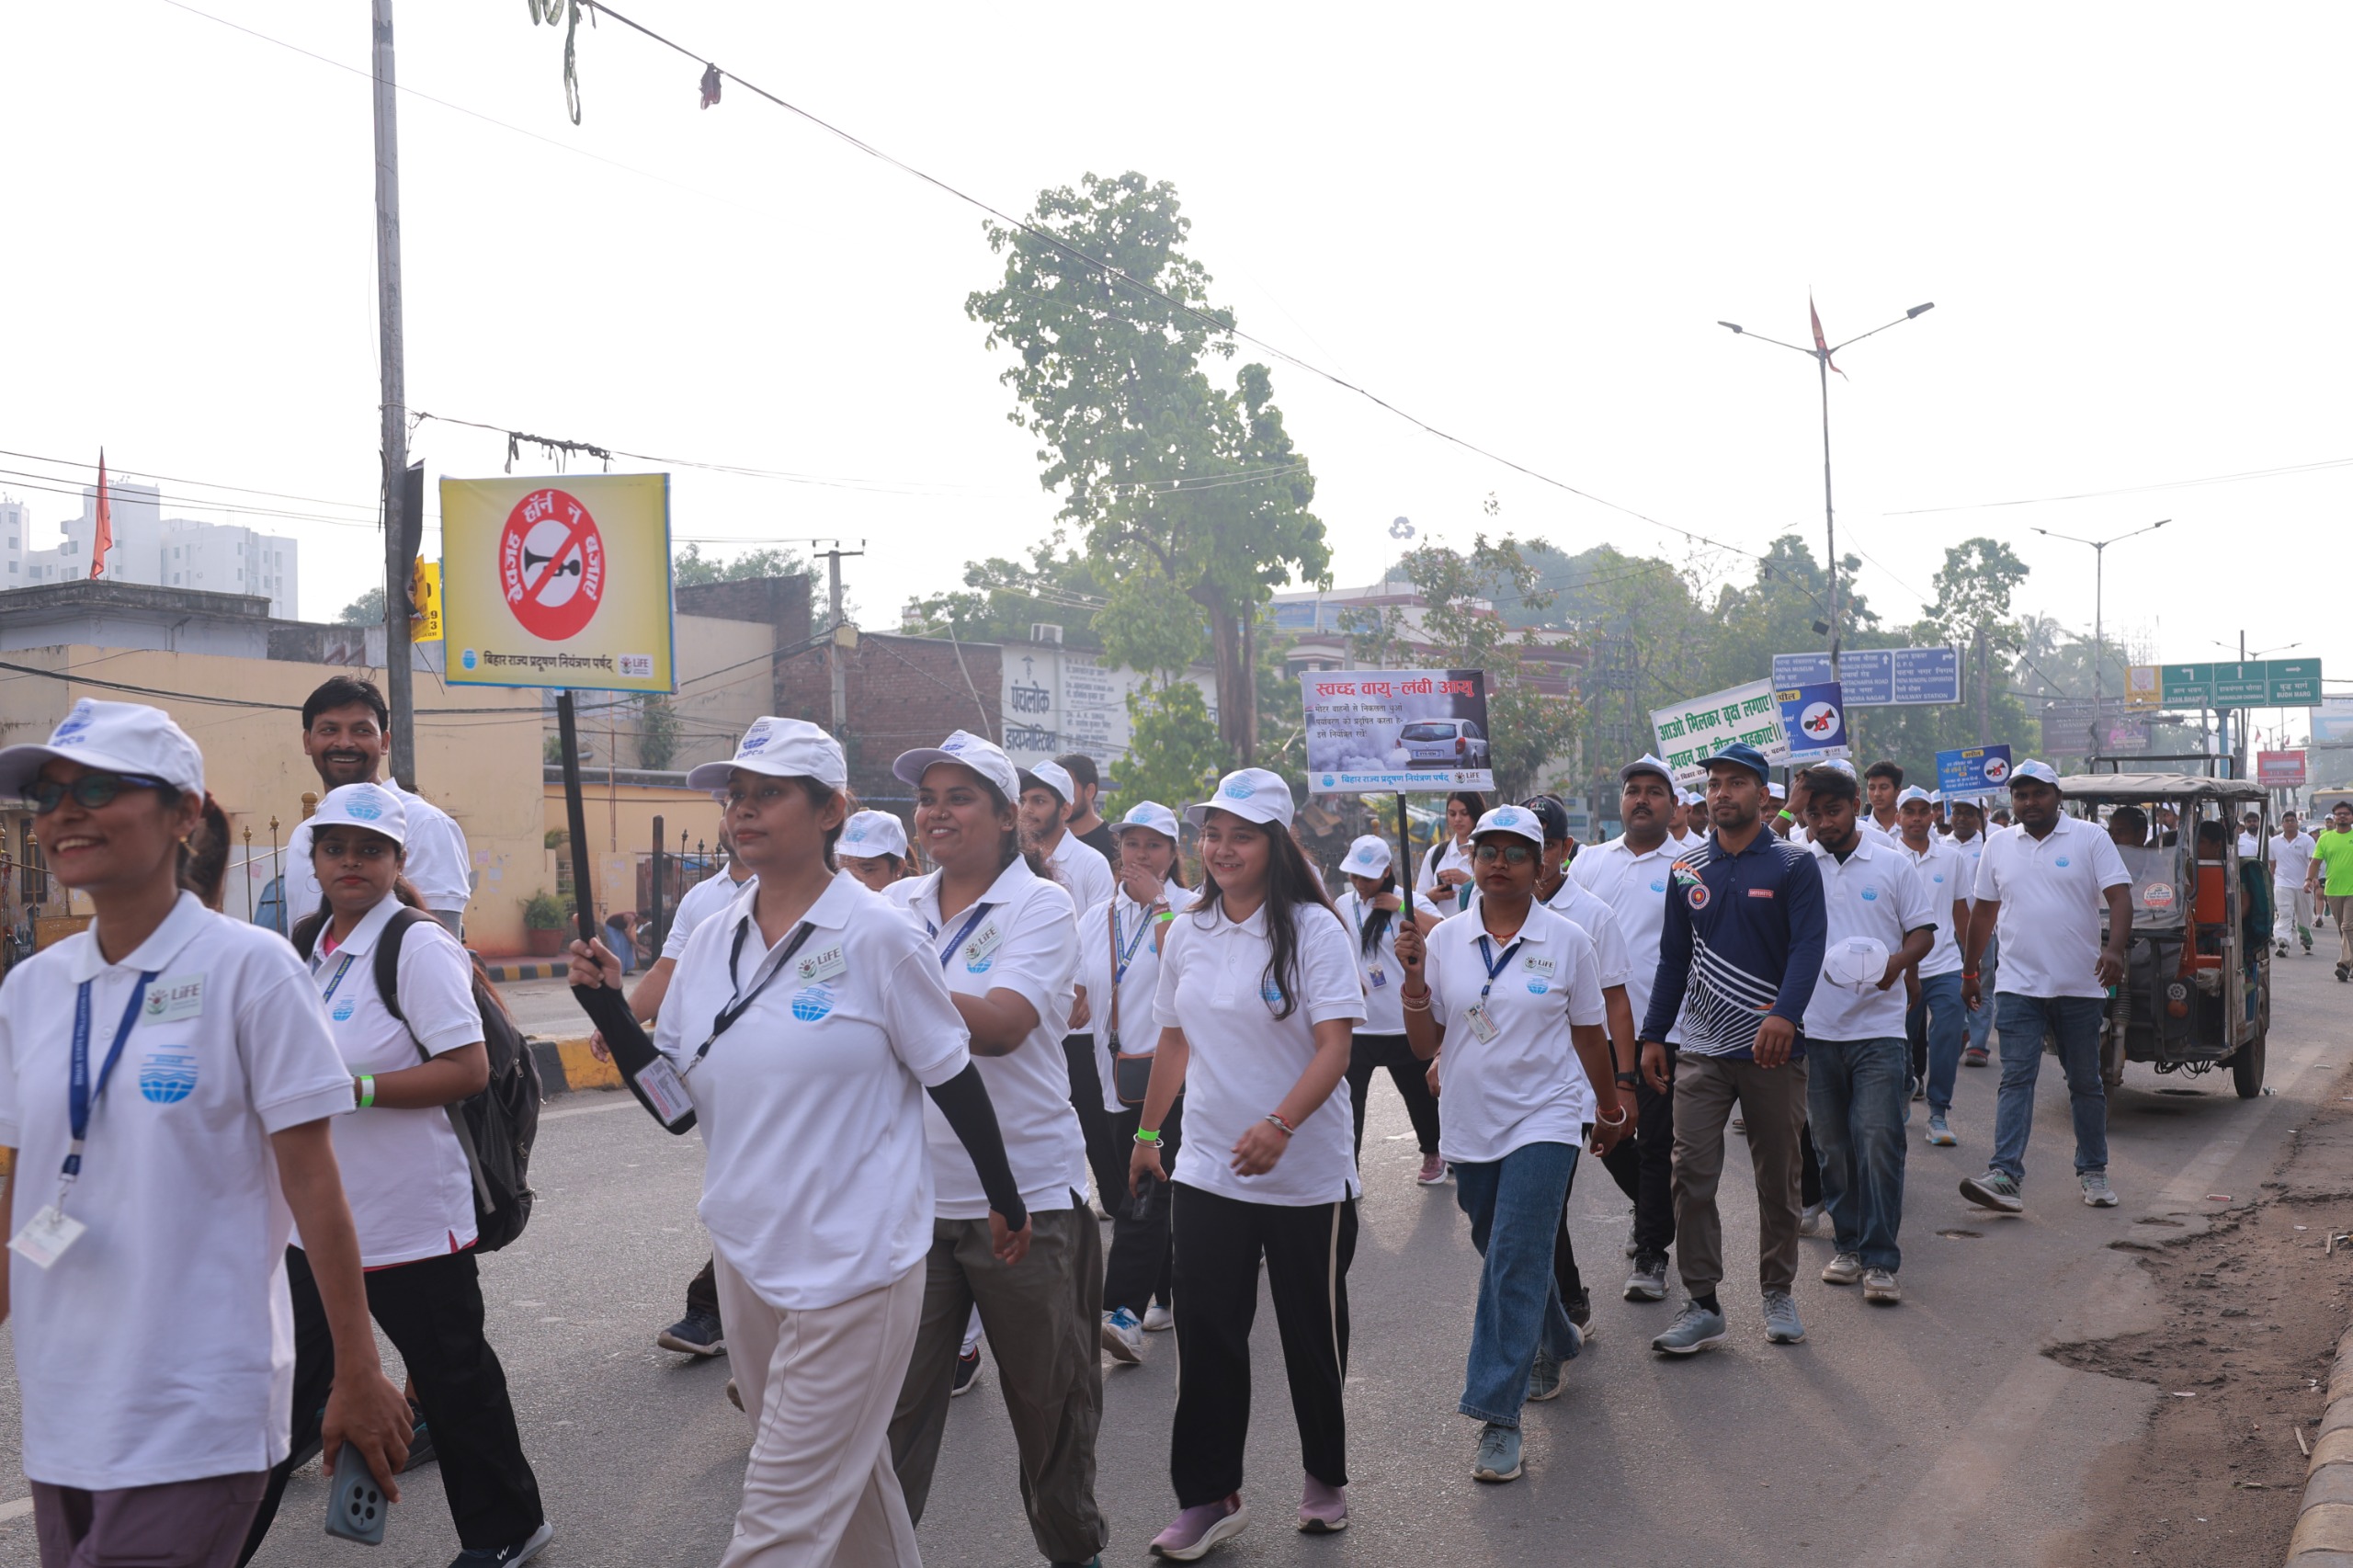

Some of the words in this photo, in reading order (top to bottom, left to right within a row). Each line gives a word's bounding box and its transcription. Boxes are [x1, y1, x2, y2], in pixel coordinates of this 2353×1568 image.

[506, 529, 524, 605] बेवजह
[522, 491, 553, 523] हॉर्न
[567, 501, 583, 525] न
[483, 650, 506, 666] बिहार
[508, 654, 528, 666] राज्य
[529, 656, 557, 672] प्रदूषण
[559, 653, 591, 669] नियंत्रण
[1315, 682, 1356, 697] स्वच्छ
[1438, 680, 1475, 698] आयु
[2294, 680, 2308, 689] मार्ग
[1011, 679, 1050, 714] पंचलोक
[1777, 691, 1796, 701] पील
[2167, 695, 2185, 703] GYAN
[1314, 703, 1329, 713] मोटर
[1332, 702, 1349, 712] वाहनों
[1352, 703, 1358, 712] से
[1360, 703, 1386, 712] निकलता
[1315, 717, 1340, 726] पर्यावरण
[1342, 716, 1351, 725] को
[1354, 717, 1374, 728] प्रदूषित
[1377, 717, 1393, 725] करता
[1658, 716, 1686, 742] आओ
[1685, 709, 1722, 733] मिलकर
[1722, 703, 1742, 728] वृक्ष
[1317, 730, 1326, 739] इसे
[1329, 729, 1353, 739] नियंत्रित
[1666, 749, 1697, 771] उपवन
[1696, 744, 1711, 761] सा
[1771, 745, 1786, 755] पटना
[1341, 774, 1361, 784] बिहार
[1363, 775, 1379, 783] राज्य
[1381, 775, 1404, 786] प्रदूषण
[1405, 772, 1431, 782] नियंत्रण
[1680, 770, 1696, 781] बिहार
[816, 948, 842, 966] LiFE
[171, 983, 200, 1001] LiFE
[75, 996, 87, 1038] POLLUTION
[74, 1039, 85, 1062] STATE
[74, 1062, 84, 1086] BIHAR
